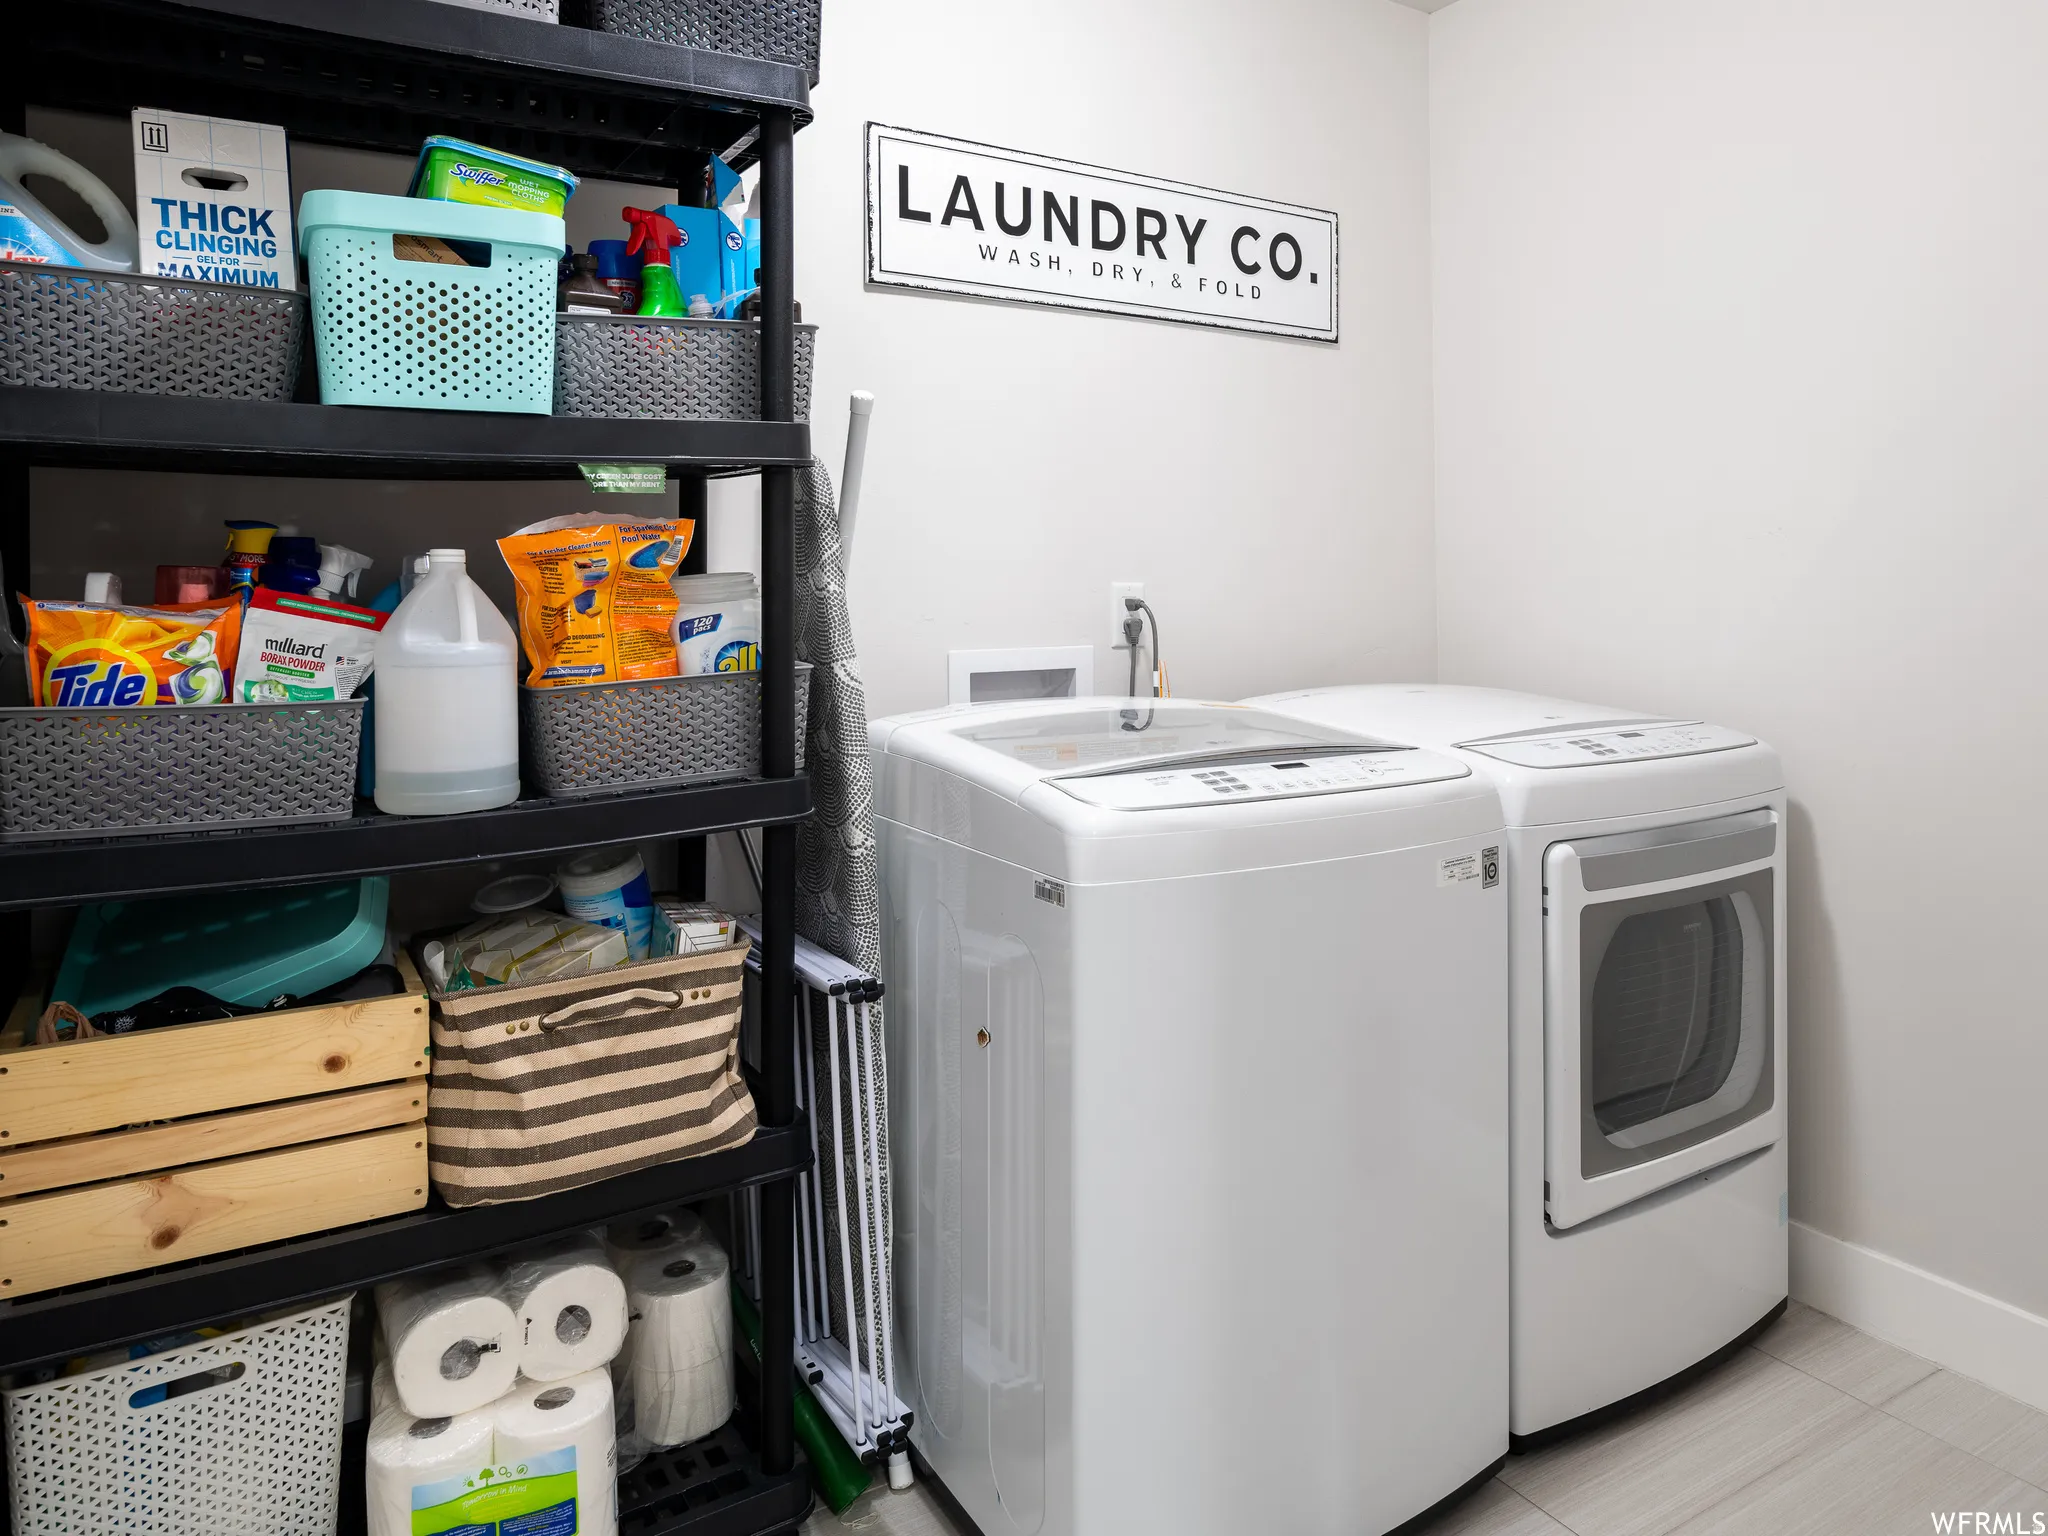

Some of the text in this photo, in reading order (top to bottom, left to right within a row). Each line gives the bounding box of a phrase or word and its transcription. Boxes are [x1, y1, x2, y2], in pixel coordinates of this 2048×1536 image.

[448, 163, 506, 186] Swiffer
[519, 178, 540, 188] WET
[507, 181, 550, 198] MOPPING
[511, 189, 546, 204] CLOTHS
[151, 197, 276, 238] THICK
[899, 164, 1318, 284] LAUNDRY CO.
[155, 229, 277, 258] CLINGING
[196, 255, 240, 266] GEL FOR
[157, 262, 279, 289] MAXIMUM
[978, 244, 1262, 300] WASH, DRY, & FOLD
[567, 543, 592, 551] Cleaner
[621, 533, 661, 543] Pool Water
[240, 554, 266, 564] MORE
[692, 624, 712, 635] pacs
[693, 616, 714, 628] 120
[265, 637, 325, 659] milliard
[718, 642, 759, 672] all
[260, 651, 326, 672] BORAX POWDER
[50, 661, 147, 706] Tide
[462, 1490, 499, 1510] Tomorrow
[499, 1486, 507, 1495] in
[508, 1484, 526, 1494] Mind
